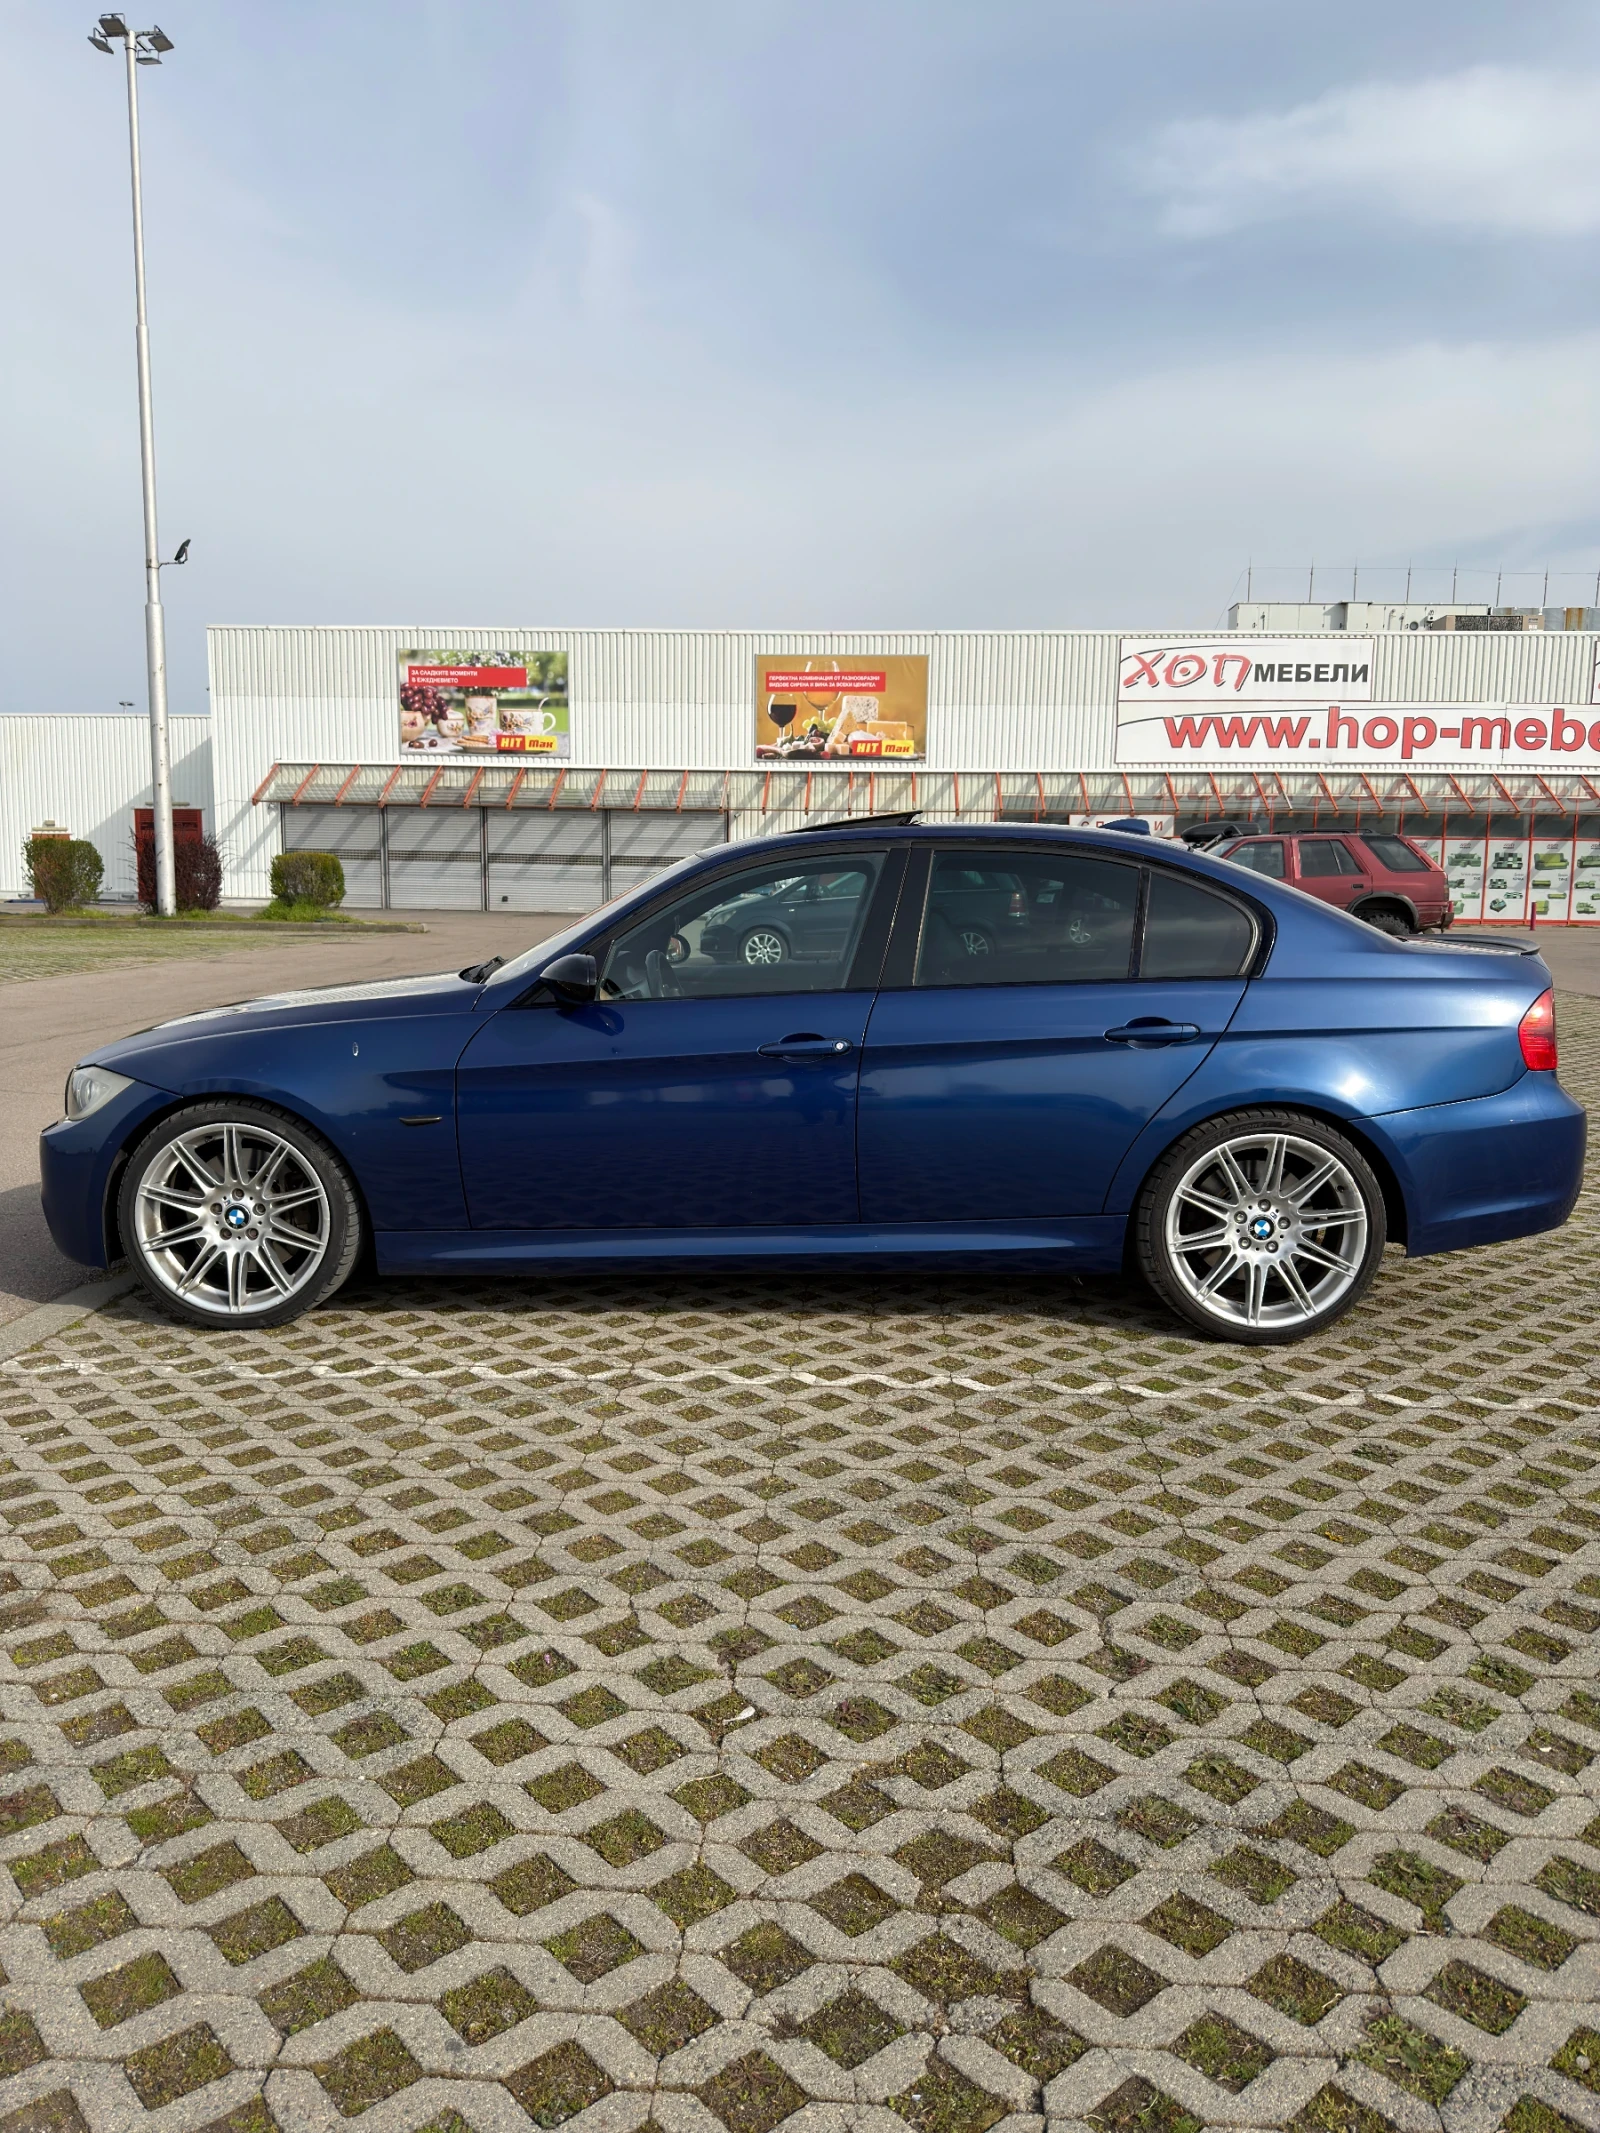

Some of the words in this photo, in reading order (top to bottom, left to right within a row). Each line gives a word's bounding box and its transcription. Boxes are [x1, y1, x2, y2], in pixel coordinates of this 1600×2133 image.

[1123, 650, 1252, 691] ХОП
[1254, 664, 1368, 682] МЕБЕЛИ
[500, 737, 523, 748] HIT
[856, 742, 879, 753] HIT
